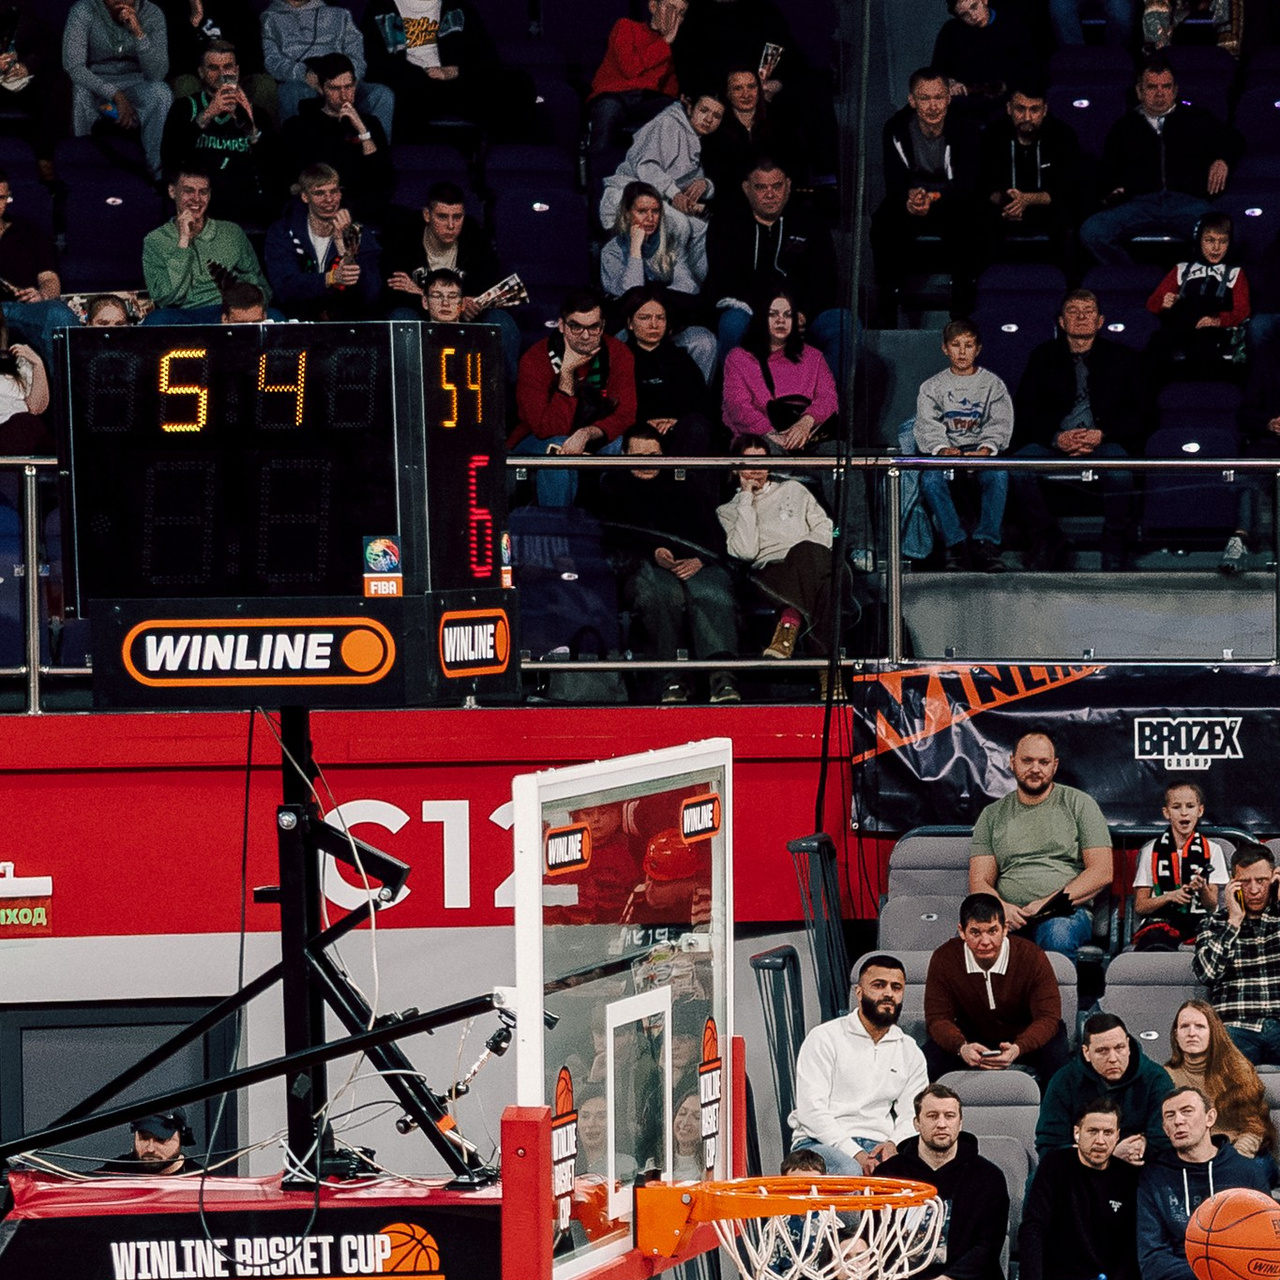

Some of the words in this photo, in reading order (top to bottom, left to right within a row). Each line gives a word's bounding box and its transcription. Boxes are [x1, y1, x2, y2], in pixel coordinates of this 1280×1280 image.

[159, 348, 208, 433] 5
[257, 351, 307, 427] 4
[441, 347, 482, 428] 54
[469, 455, 493, 578] 6
[370, 581, 397, 596] FIBA
[145, 634, 334, 672] WINLINE
[442, 624, 496, 663] WINLINE
[1138, 719, 1241, 758] BROZEX
[1165, 757, 1210, 769] GROUP
[684, 803, 714, 835] WINLINE
[548, 833, 582, 865] WINLINE
[110, 1239, 228, 1280] WINLINE
[235, 1236, 334, 1277] BASKET
[340, 1234, 392, 1274] CUP
